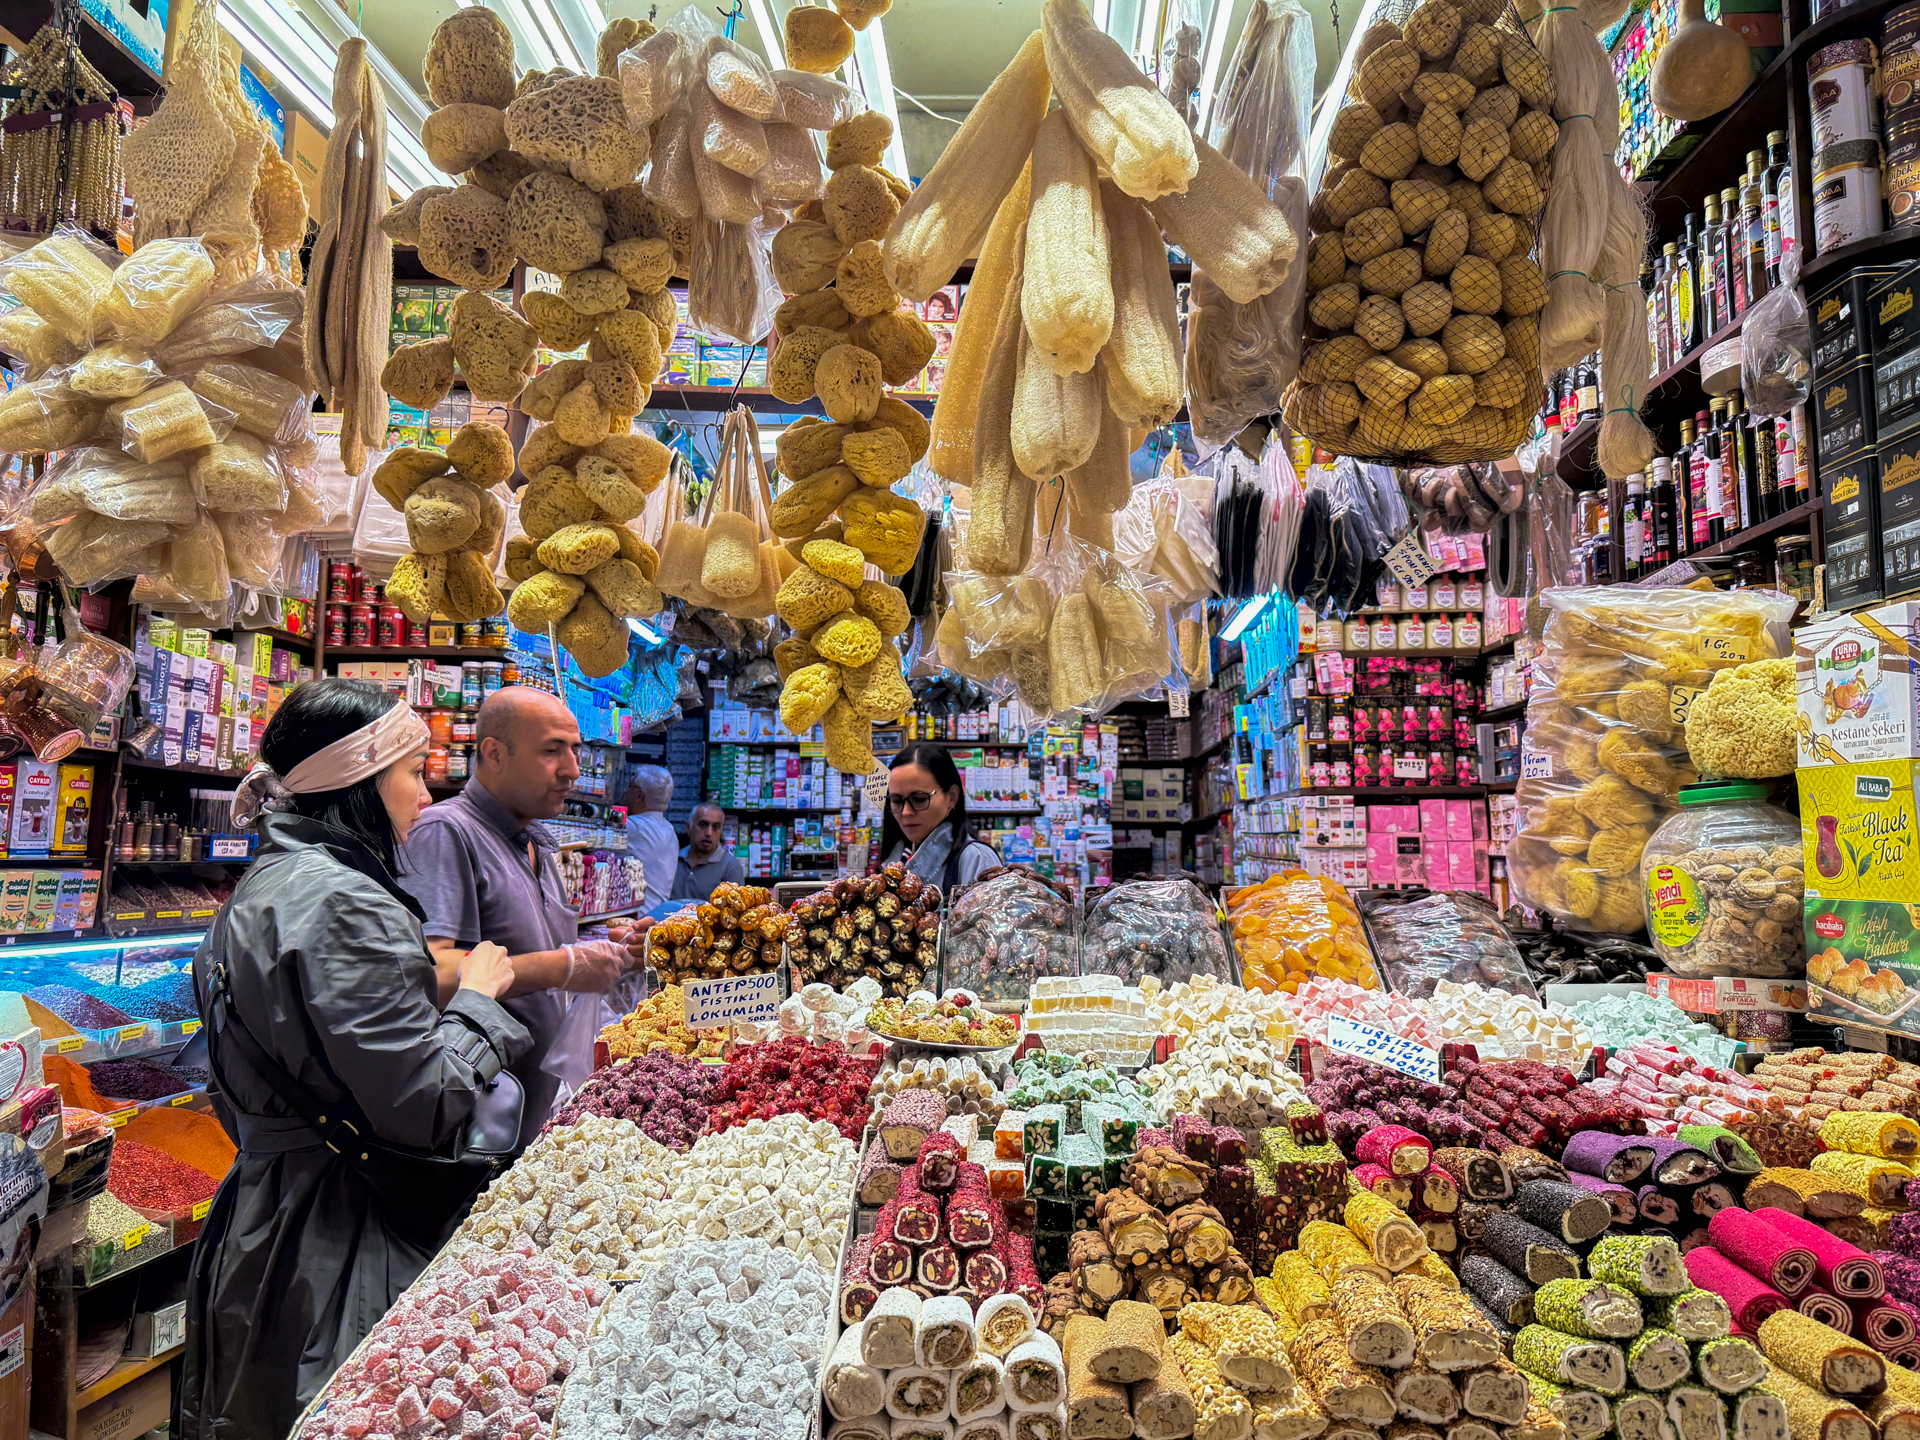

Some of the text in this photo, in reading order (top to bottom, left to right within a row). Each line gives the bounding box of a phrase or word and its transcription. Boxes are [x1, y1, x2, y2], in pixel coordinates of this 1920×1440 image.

[1720, 651, 1736, 660] 20
[1834, 641, 1858, 657] TURKO
[1834, 652, 1857, 661] BABA
[1831, 720, 1906, 742] Kestane Şekeri
[1525, 768, 1538, 778] 20
[1869, 781, 1883, 793] BABA
[1862, 805, 1910, 839] Black
[1873, 837, 1904, 866] Tea
[1853, 930, 1910, 961] Baklava
[690, 975, 776, 999] ANTEP 500
[1722, 996, 1758, 1004] PORTAKAL
[690, 1003, 775, 1023] LOKUMLAR
[1349, 1021, 1425, 1053] TURKISH
[1384, 1055, 1437, 1077] HONEY
